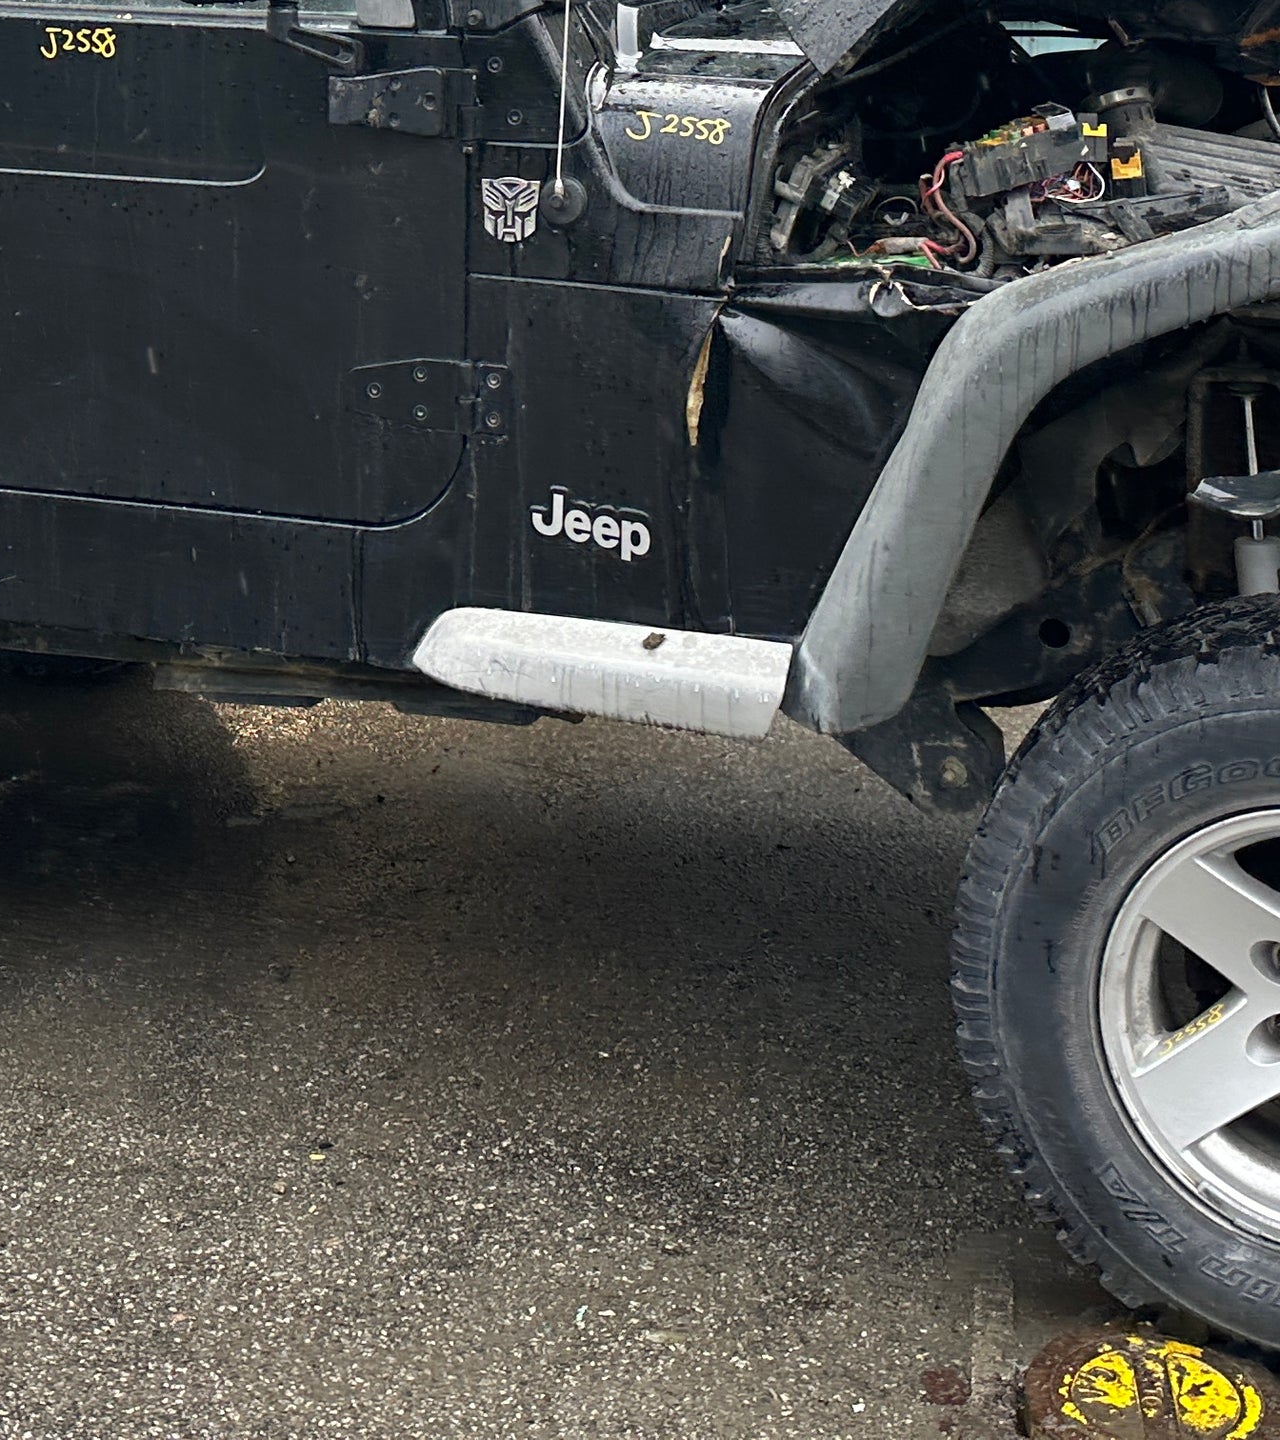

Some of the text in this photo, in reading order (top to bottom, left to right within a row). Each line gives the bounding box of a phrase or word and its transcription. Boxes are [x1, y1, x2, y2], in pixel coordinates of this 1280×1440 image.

[40, 27, 116, 59] J2558
[625, 111, 732, 145] J2558
[531, 492, 651, 562] Jeep
[1159, 1003, 1224, 1056] J2558
